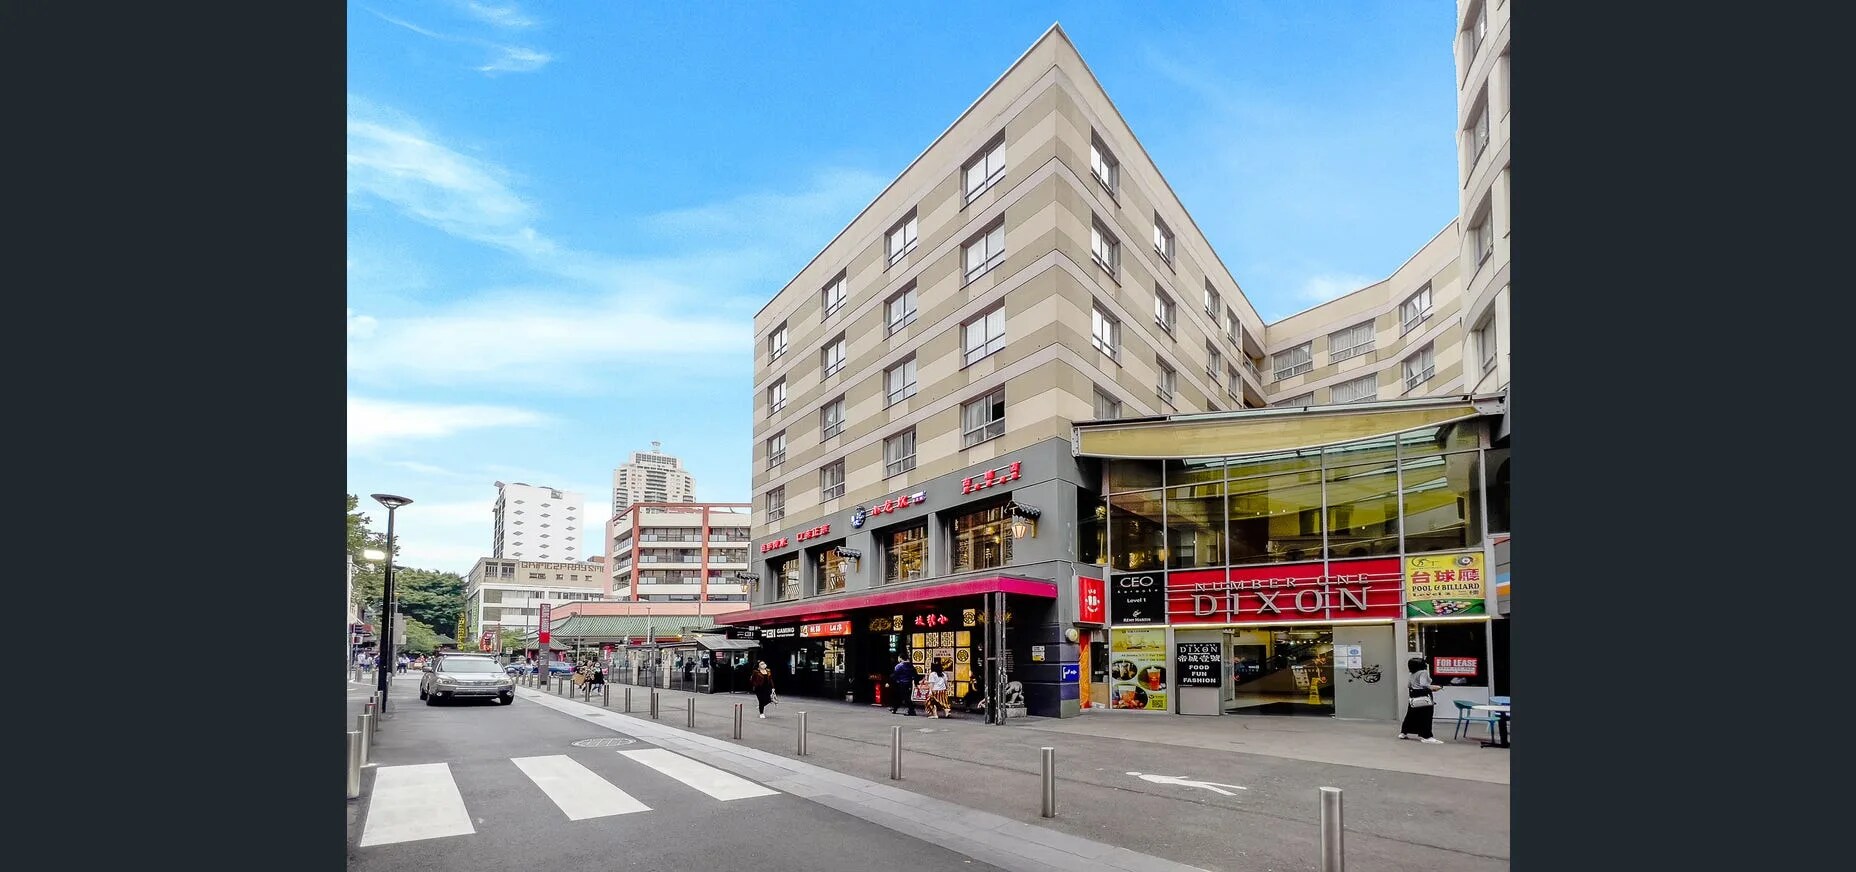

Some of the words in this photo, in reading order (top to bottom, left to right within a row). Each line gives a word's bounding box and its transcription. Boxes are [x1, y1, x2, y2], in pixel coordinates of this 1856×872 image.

[1120, 576, 1153, 587] CEO
[1195, 577, 1296, 592] NUMBER
[1316, 573, 1369, 586] ONE
[1411, 568, 1480, 584] 台球廳
[1190, 585, 1373, 616] DIXON
[1436, 659, 1451, 667] FOR
[1453, 659, 1477, 667] LEASE
